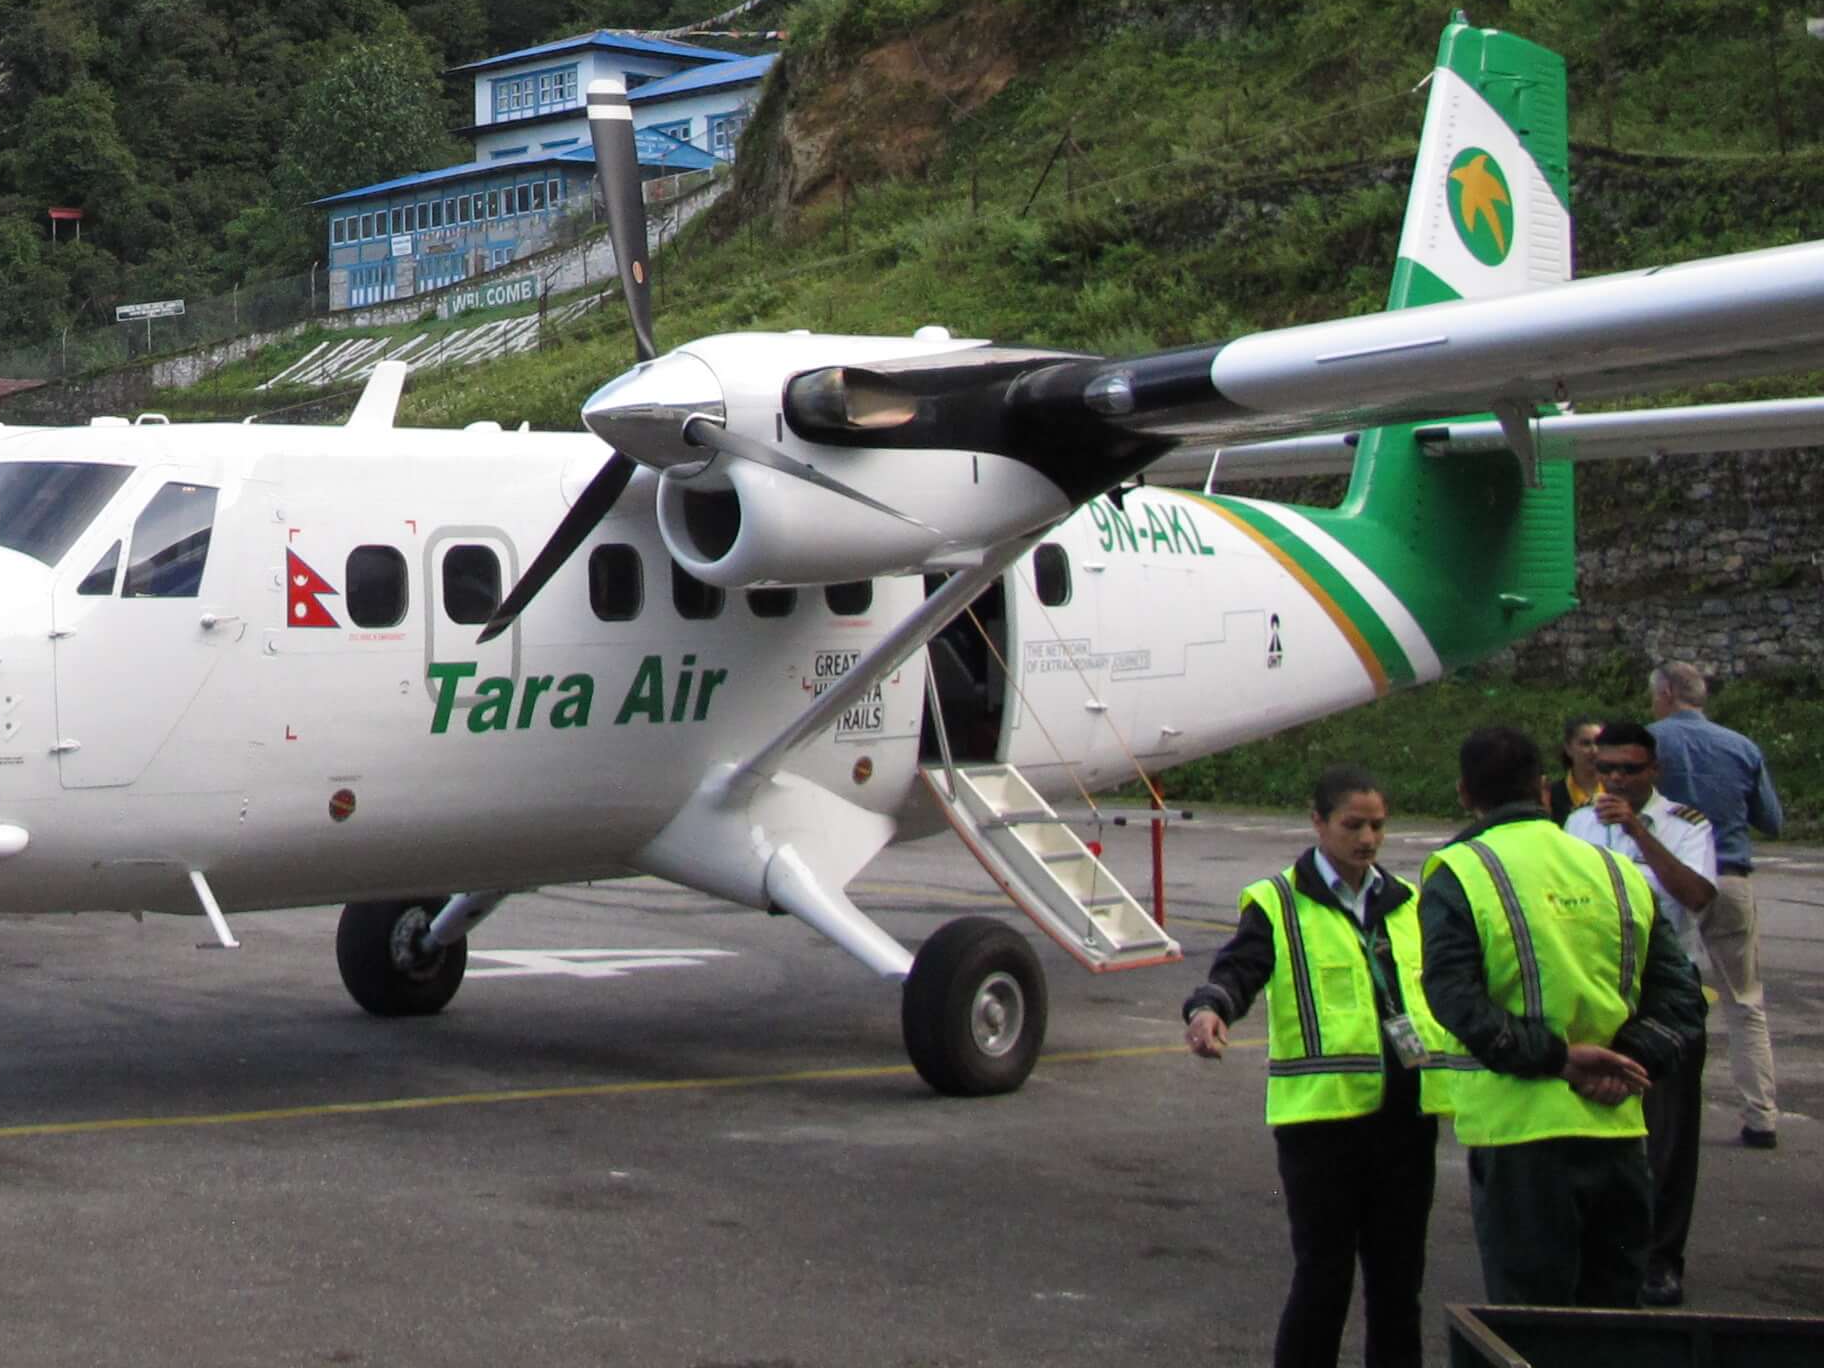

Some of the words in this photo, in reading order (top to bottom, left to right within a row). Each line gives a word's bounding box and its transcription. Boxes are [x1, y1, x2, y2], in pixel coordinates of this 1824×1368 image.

[1087, 499, 1215, 556] 9N-AKL
[427, 661, 594, 734] Tara
[614, 653, 728, 725] Air
[815, 653, 858, 677] GREAT
